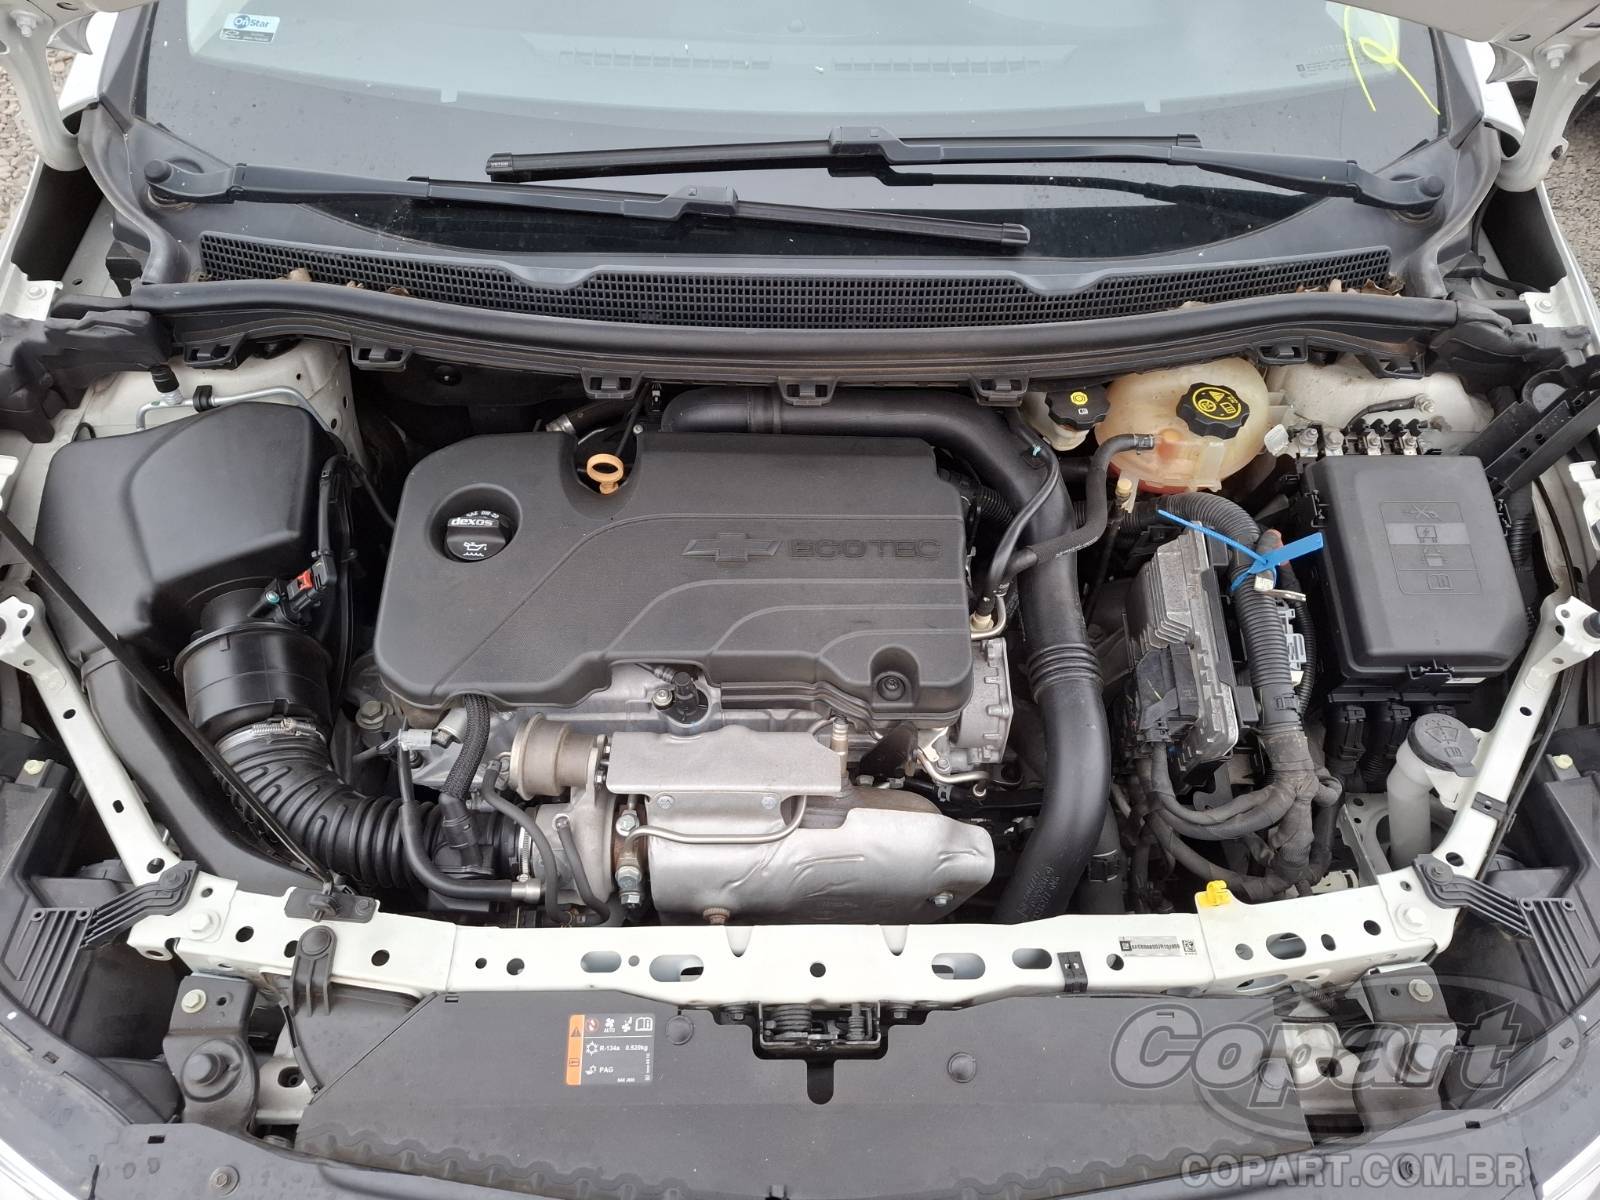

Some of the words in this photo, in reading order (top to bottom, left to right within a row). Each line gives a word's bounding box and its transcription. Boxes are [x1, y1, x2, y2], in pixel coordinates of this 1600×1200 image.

[234, 15, 268, 28] OnStar
[451, 517, 493, 526] dexos
[791, 539, 942, 559] ECOTEC
